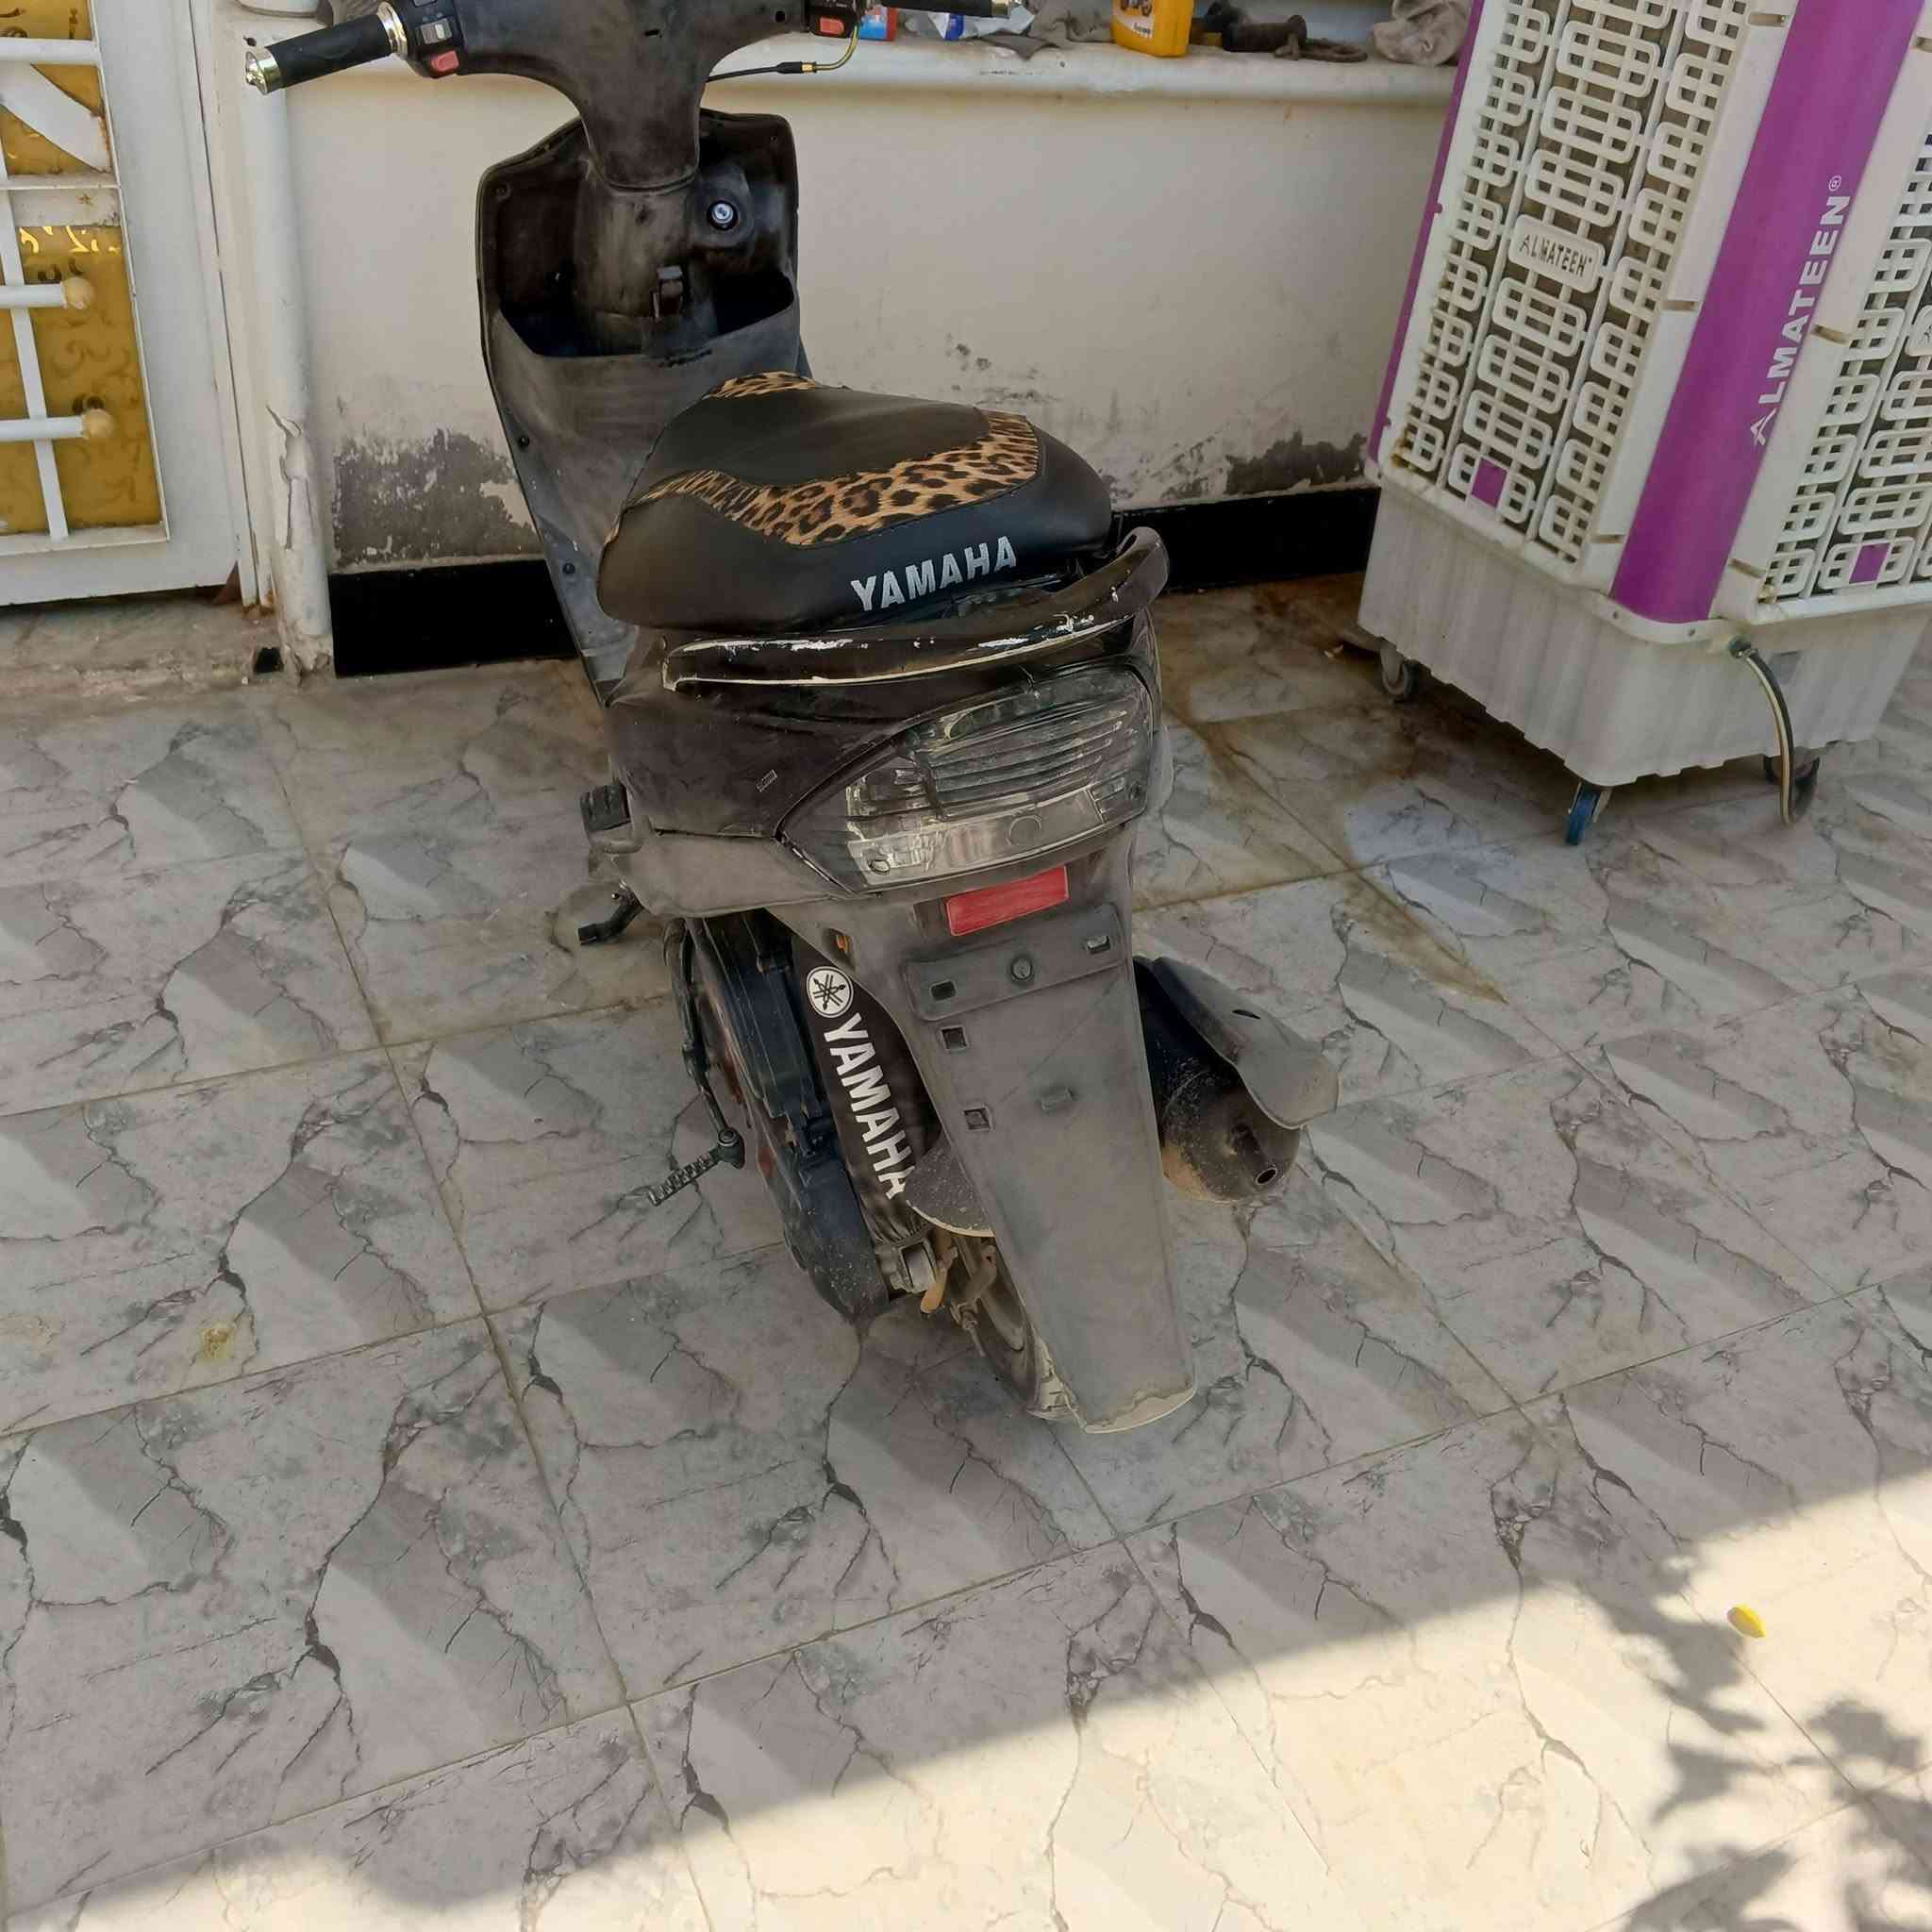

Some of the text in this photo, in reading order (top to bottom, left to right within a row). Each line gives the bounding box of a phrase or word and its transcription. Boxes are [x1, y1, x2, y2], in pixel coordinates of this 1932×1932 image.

[1750, 195, 1851, 446] ALMATEEN
[850, 535, 1017, 612] YAMAHA
[823, 1011, 916, 1201] YAMAHA
